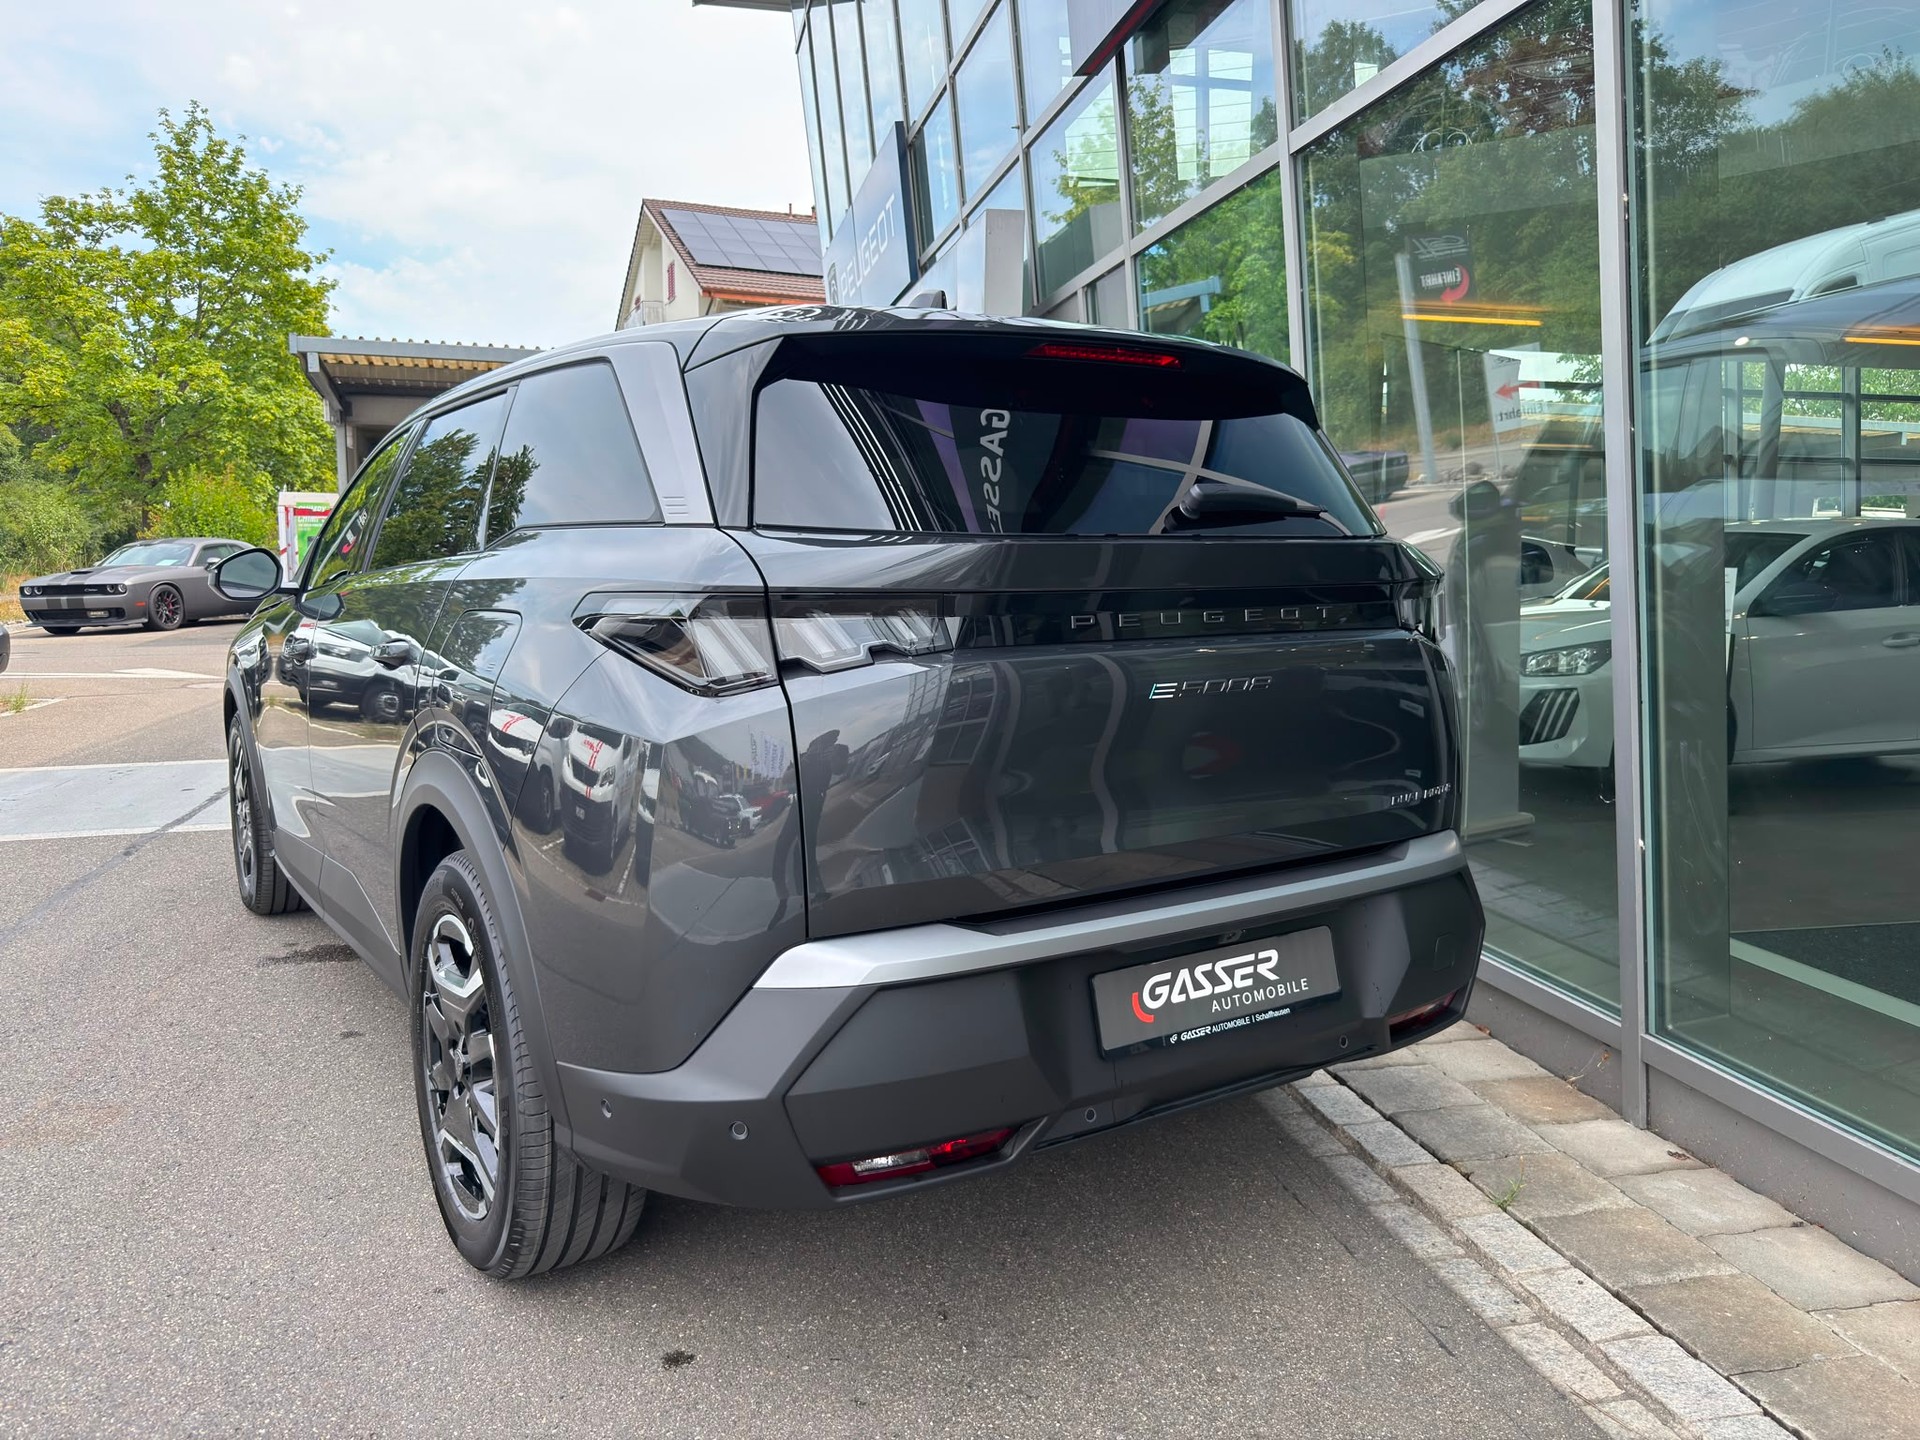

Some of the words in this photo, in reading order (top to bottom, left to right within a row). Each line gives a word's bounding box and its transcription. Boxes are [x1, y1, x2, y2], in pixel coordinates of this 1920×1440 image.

[840, 192, 896, 301] PEUGEOT
[1070, 605, 1334, 629] PEUGEOT
[1142, 949, 1280, 1010] GASSER
[1211, 978, 1309, 1013] AUTOMOBILE
[1180, 1025, 1212, 1041] GASSER
[1212, 1016, 1250, 1034] AUTOMOBILE
[1255, 1007, 1291, 1022] Schaffhausen
